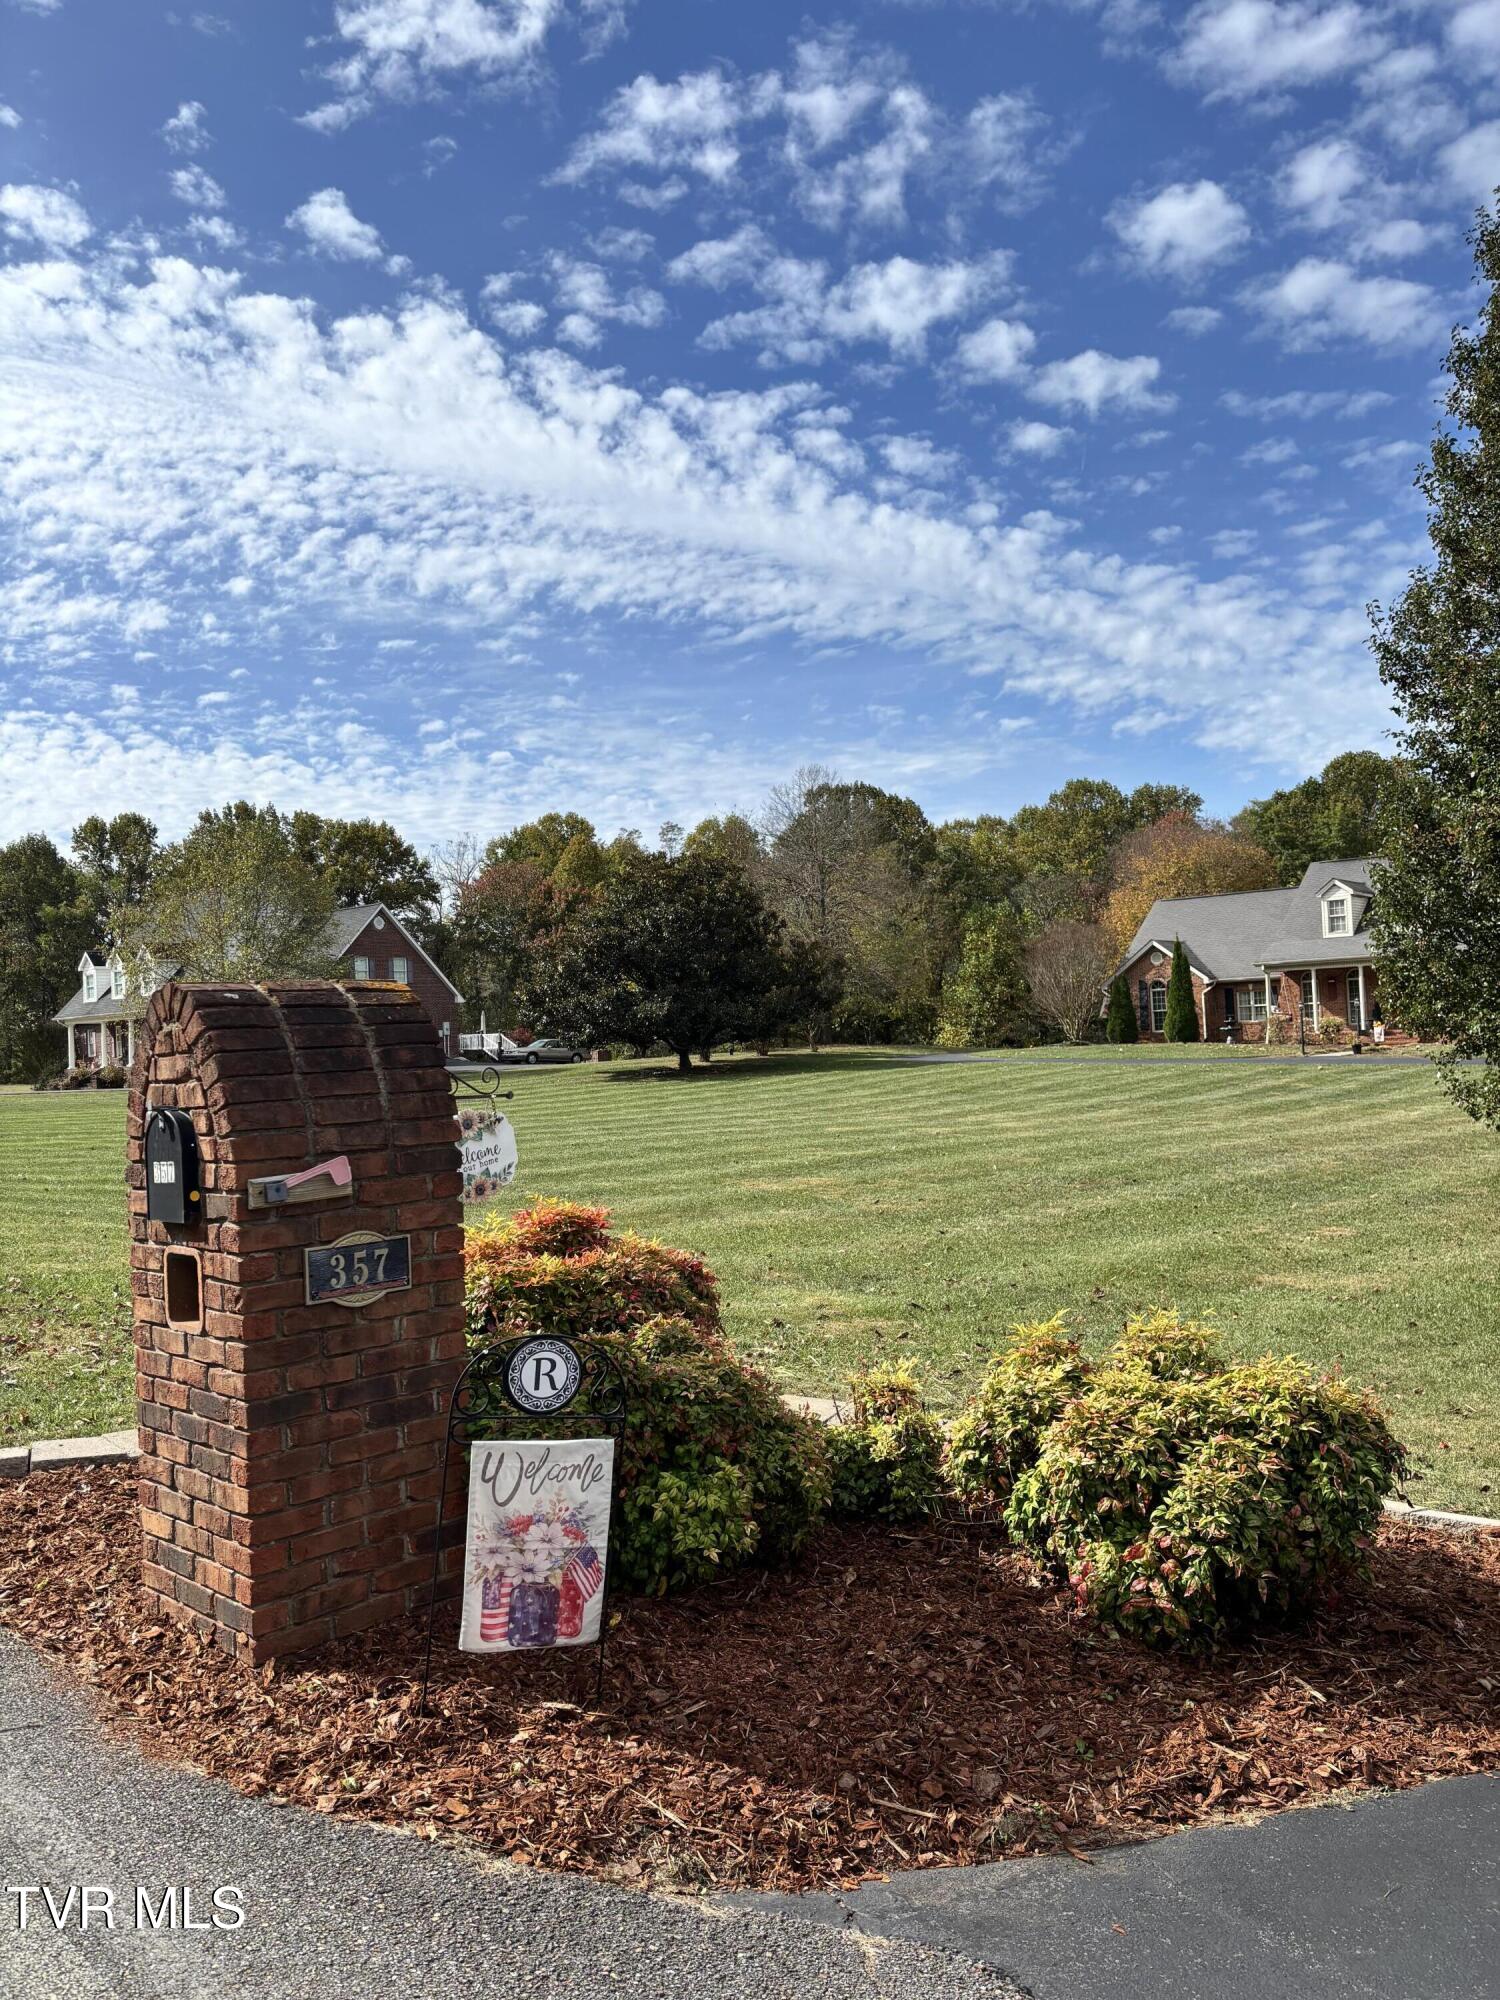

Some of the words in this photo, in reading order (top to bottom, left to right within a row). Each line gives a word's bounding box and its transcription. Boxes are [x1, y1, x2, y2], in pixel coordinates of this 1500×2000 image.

[154, 1162, 174, 1183] 357
[463, 1164, 477, 1173] our
[480, 1157, 499, 1168] home
[330, 1248, 389, 1288] 357
[532, 1357, 559, 1391] R
[481, 1448, 606, 1507] Welcome
